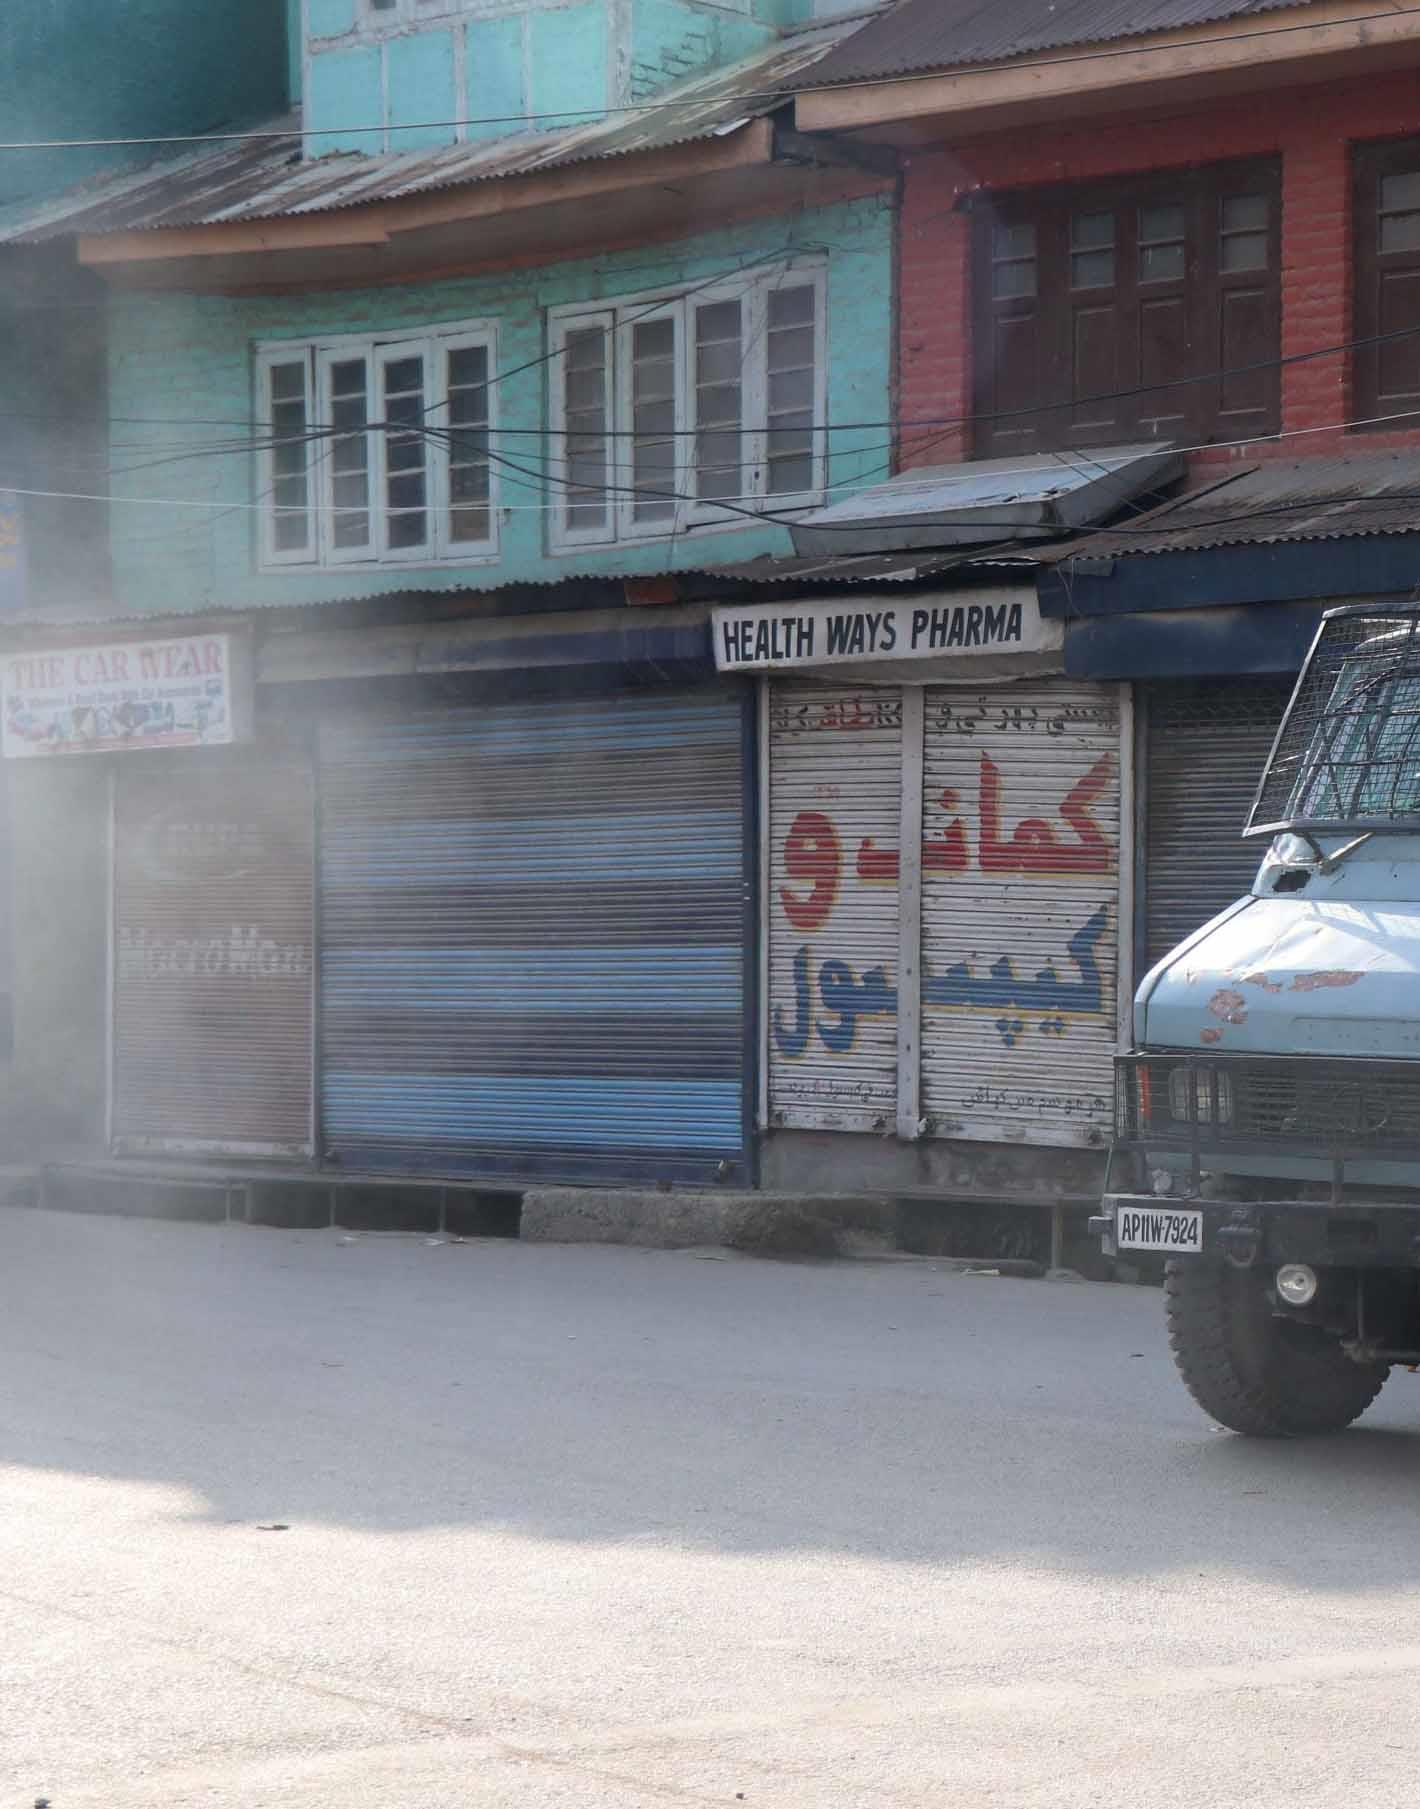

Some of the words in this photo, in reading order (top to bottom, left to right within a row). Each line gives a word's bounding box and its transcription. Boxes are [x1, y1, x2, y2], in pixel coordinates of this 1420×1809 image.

[723, 617, 815, 662] HEALTH
[827, 611, 896, 655] WAYS
[911, 603, 1023, 649] PHARMA
[12, 657, 64, 689] THE
[74, 651, 129, 686] CAR
